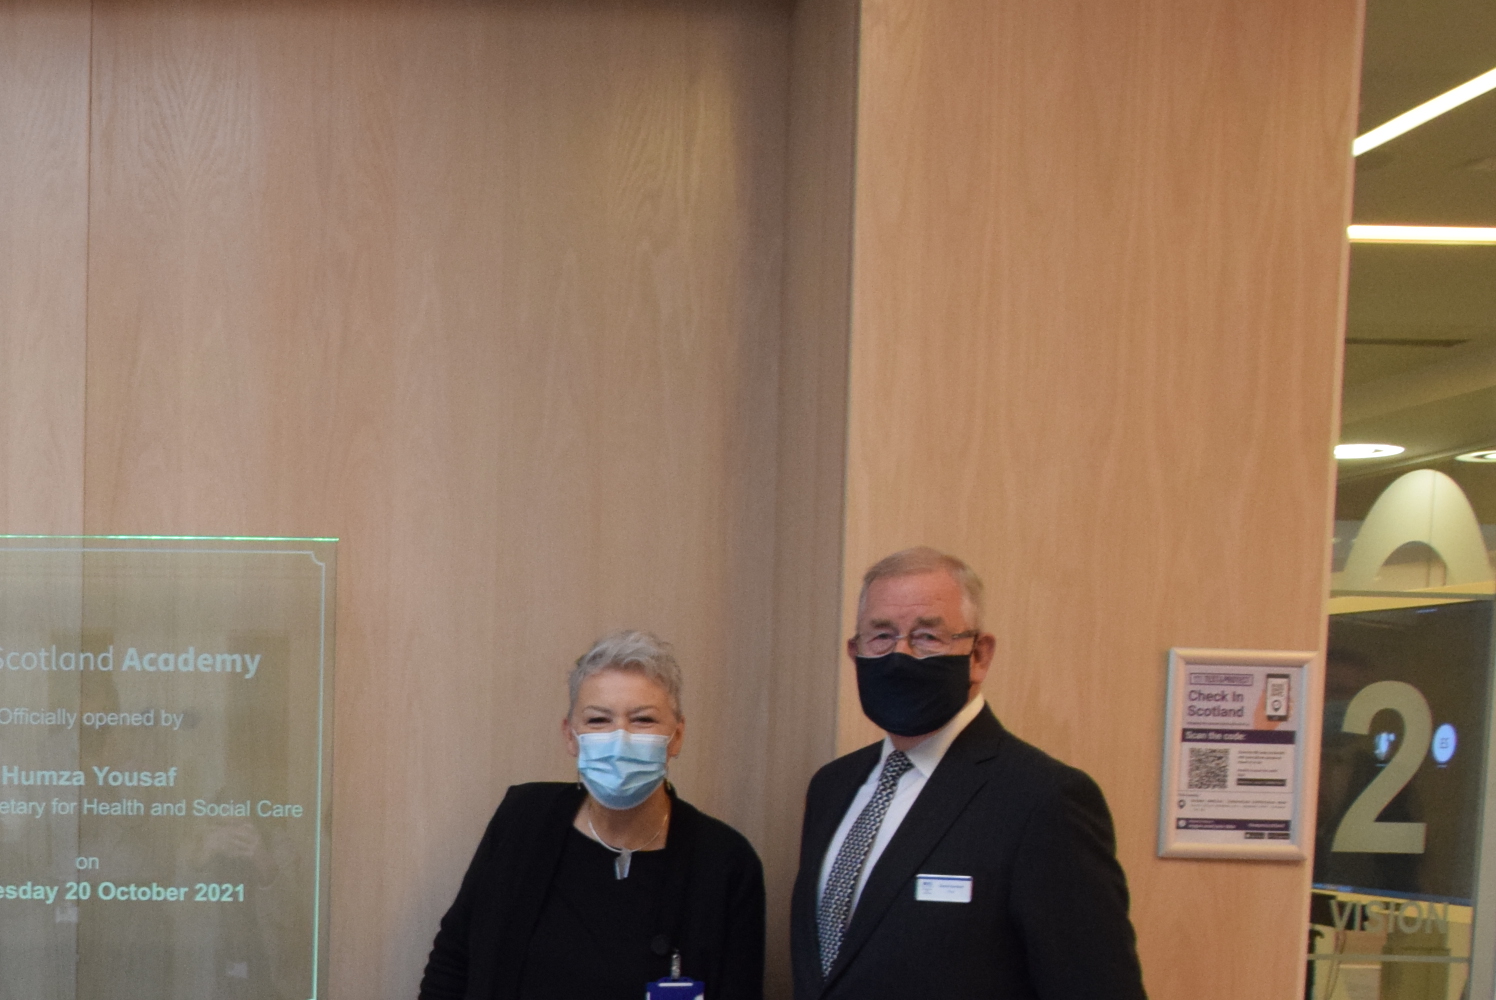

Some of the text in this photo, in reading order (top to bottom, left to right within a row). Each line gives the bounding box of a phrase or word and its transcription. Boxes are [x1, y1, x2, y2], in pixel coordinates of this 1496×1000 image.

[122, 647, 261, 678] Academy
[1188, 690, 1244, 702] Check In
[82, 710, 155, 729] opened
[160, 711, 184, 730] by
[1187, 705, 1244, 717] Scotland
[2, 766, 177, 787] Humza Yousaf
[1331, 680, 1433, 854] 2
[51, 798, 77, 815] for
[83, 799, 145, 816] Health
[151, 800, 186, 817] and
[193, 800, 251, 817] Social
[257, 801, 303, 818] Care
[75, 855, 100, 870] on
[66, 882, 91, 900] 20
[98, 882, 188, 902] October
[195, 883, 245, 902] 2021
[1330, 900, 1449, 935] VISION
